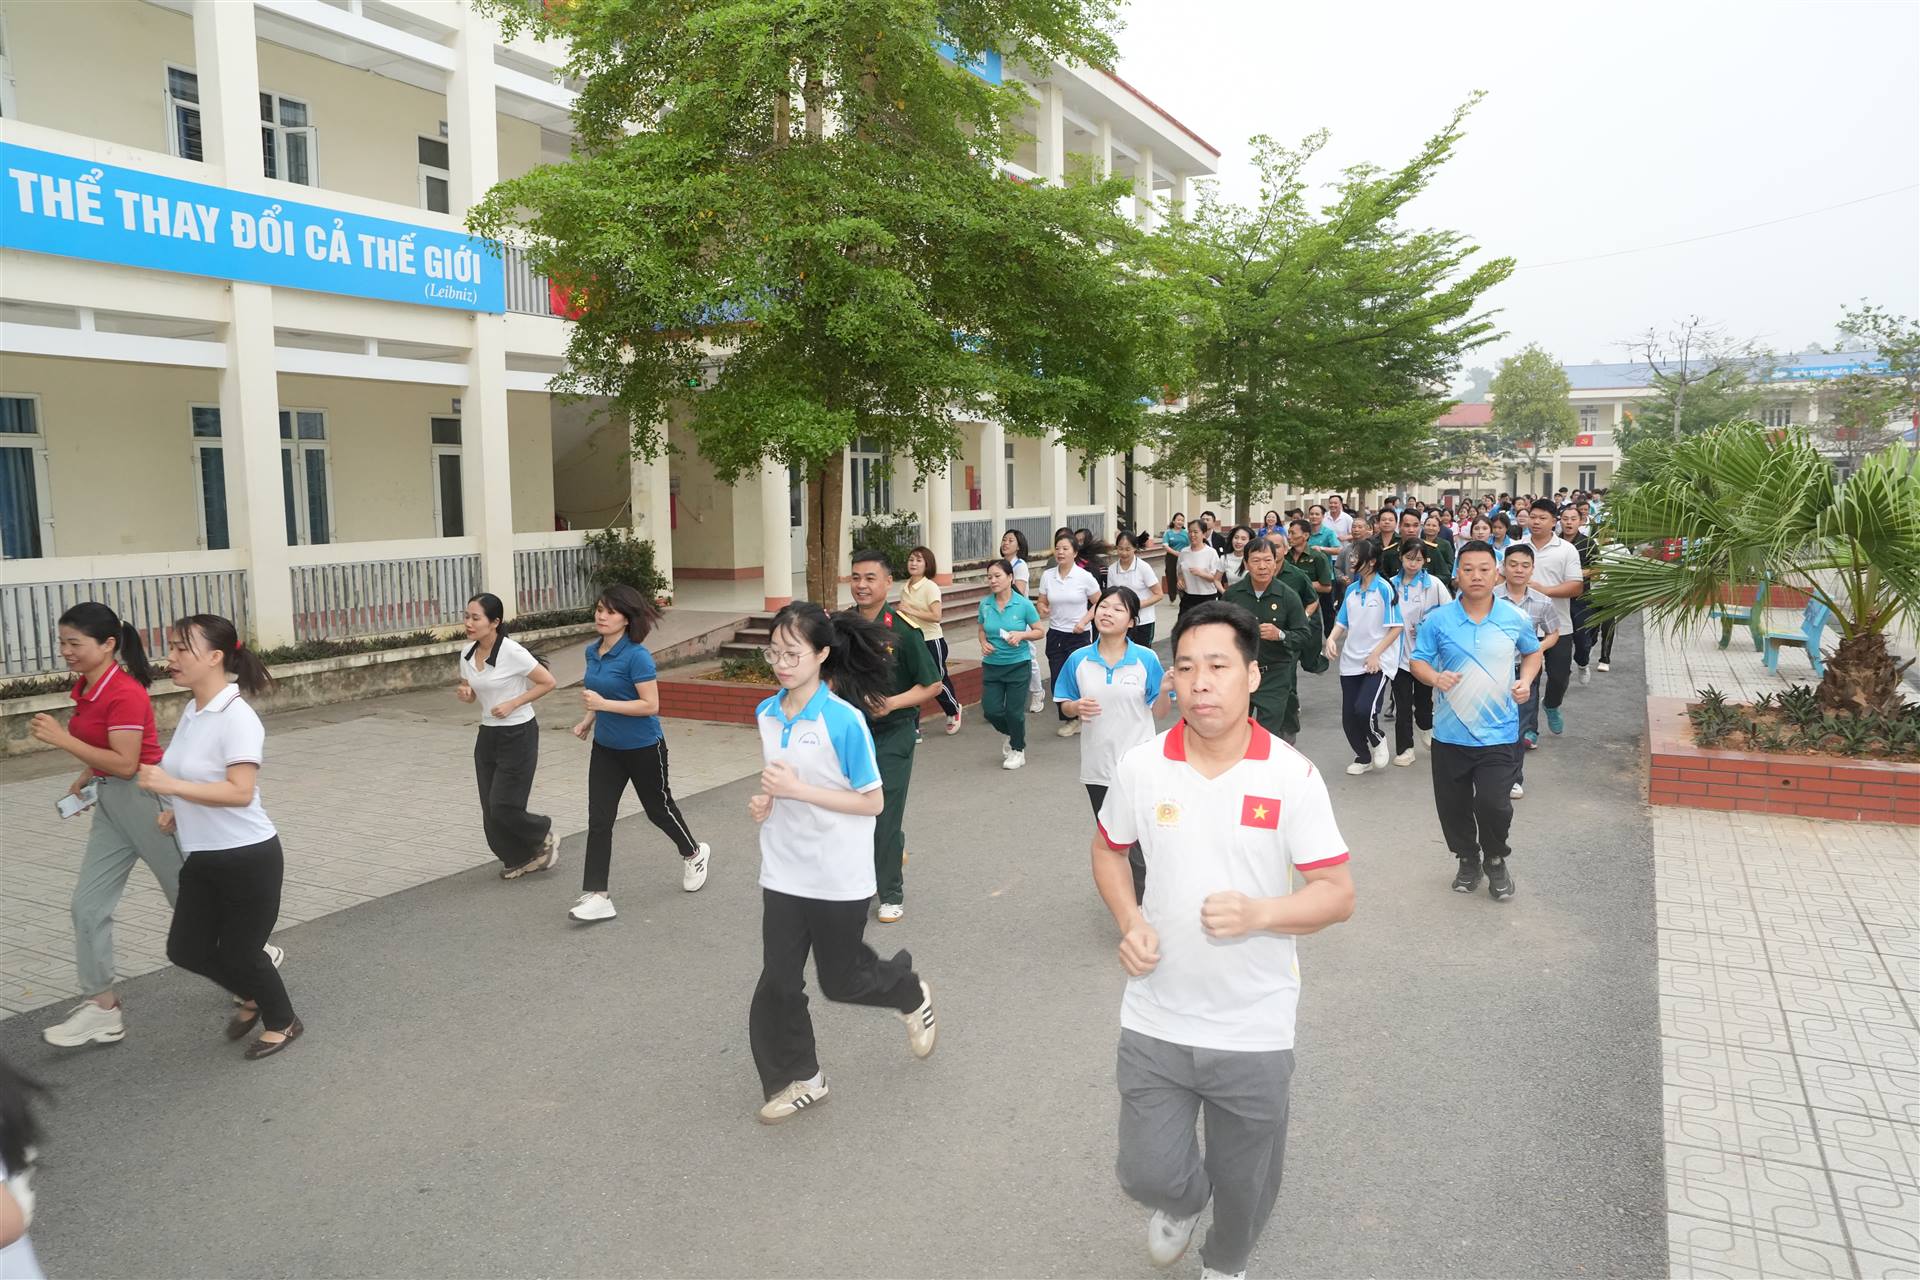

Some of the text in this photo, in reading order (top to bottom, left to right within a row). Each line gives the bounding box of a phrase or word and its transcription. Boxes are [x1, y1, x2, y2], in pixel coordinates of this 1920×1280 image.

[9, 168, 481, 284] THỂ THAY ĐỔI CẢ THẾ GIỚI
[424, 282, 478, 304] (Leibniz)
